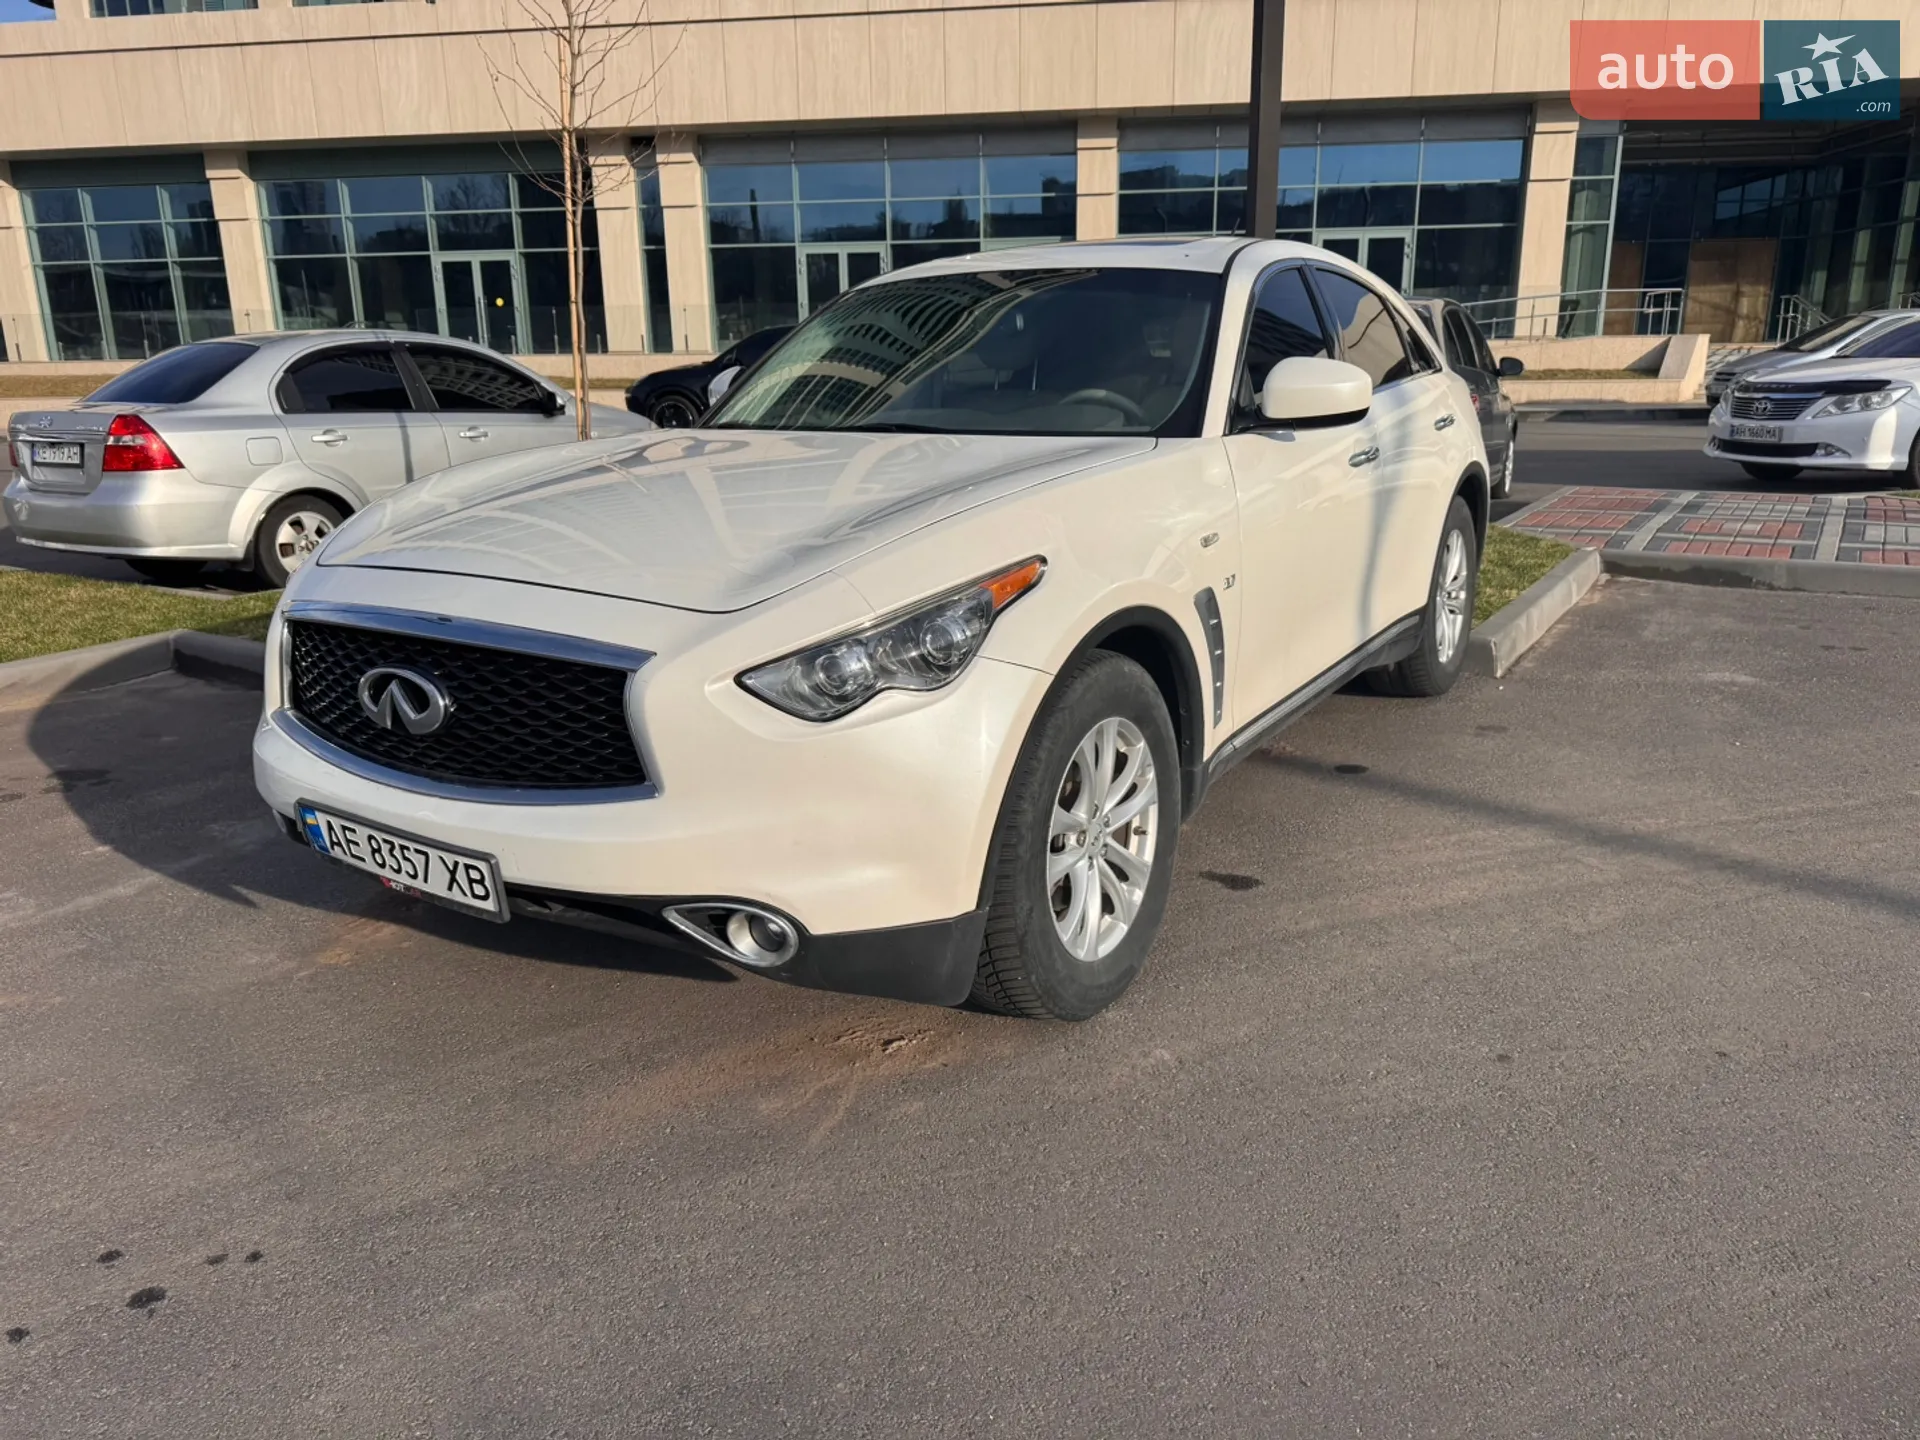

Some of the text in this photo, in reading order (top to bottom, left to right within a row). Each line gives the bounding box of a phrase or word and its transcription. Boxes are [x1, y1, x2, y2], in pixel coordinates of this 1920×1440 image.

[326, 819, 367, 863] AE
[367, 833, 431, 884] 8357
[438, 854, 491, 901] XB
